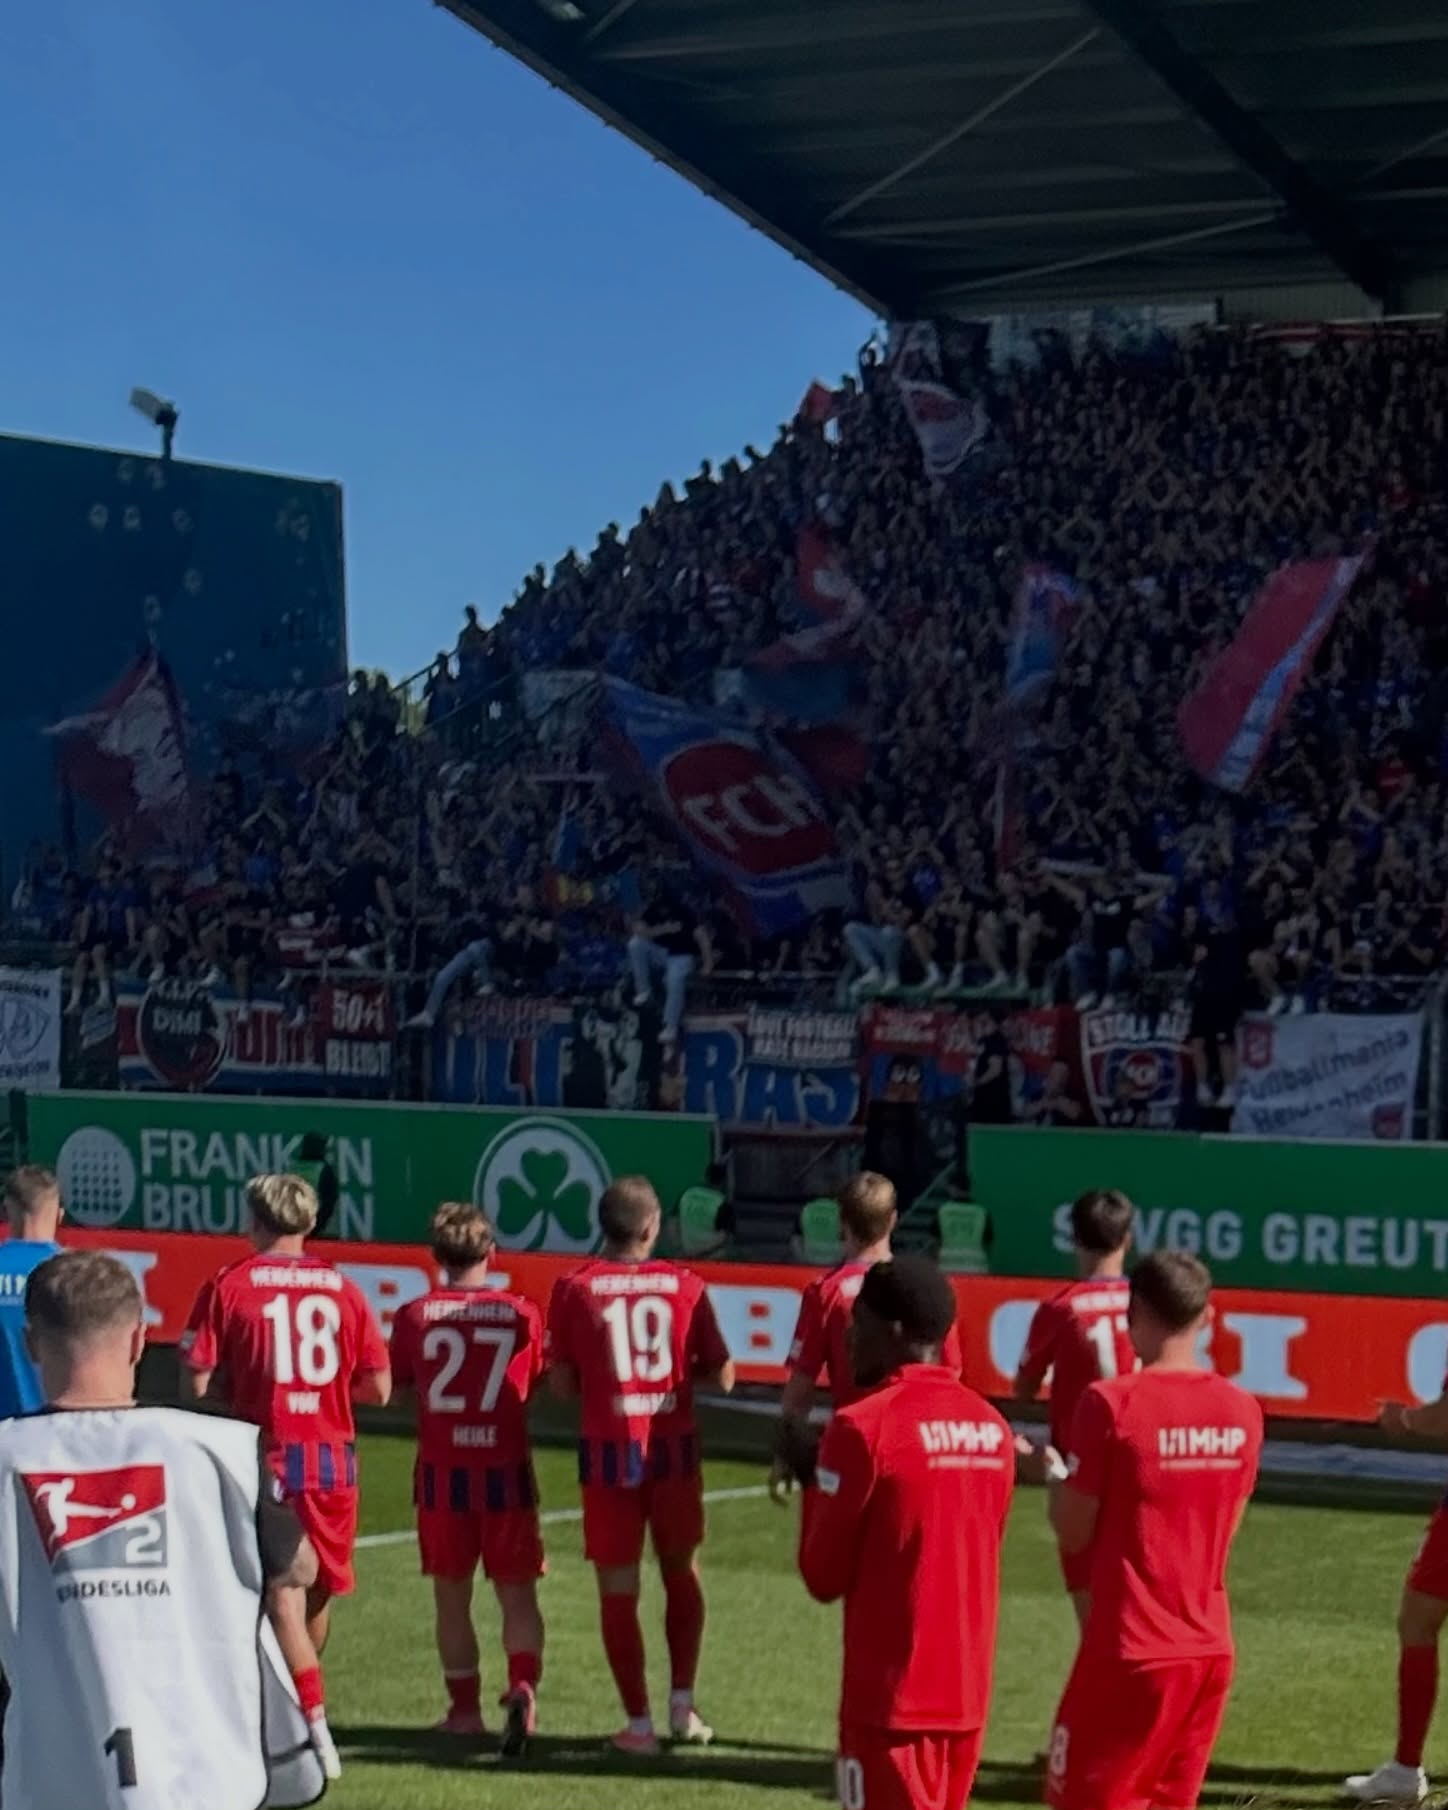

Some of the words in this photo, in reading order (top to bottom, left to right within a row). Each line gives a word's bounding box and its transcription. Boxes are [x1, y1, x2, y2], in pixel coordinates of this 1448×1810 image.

[331, 988, 386, 1034] 50+1
[324, 1037, 392, 1078] BLEIBT
[141, 1127, 373, 1187] FRANKN
[141, 1182, 374, 1240] BRUN
[1051, 1203, 1243, 1261] SVGG
[262, 1292, 341, 1387] 18
[602, 1295, 673, 1384] 19
[1086, 1315, 1129, 1378] 1
[422, 1326, 517, 1415] 27
[951, 1420, 1005, 1455] MHP
[1189, 1426, 1247, 1457] MHP
[125, 1516, 163, 1564] 2
[103, 1726, 138, 1787] 1
